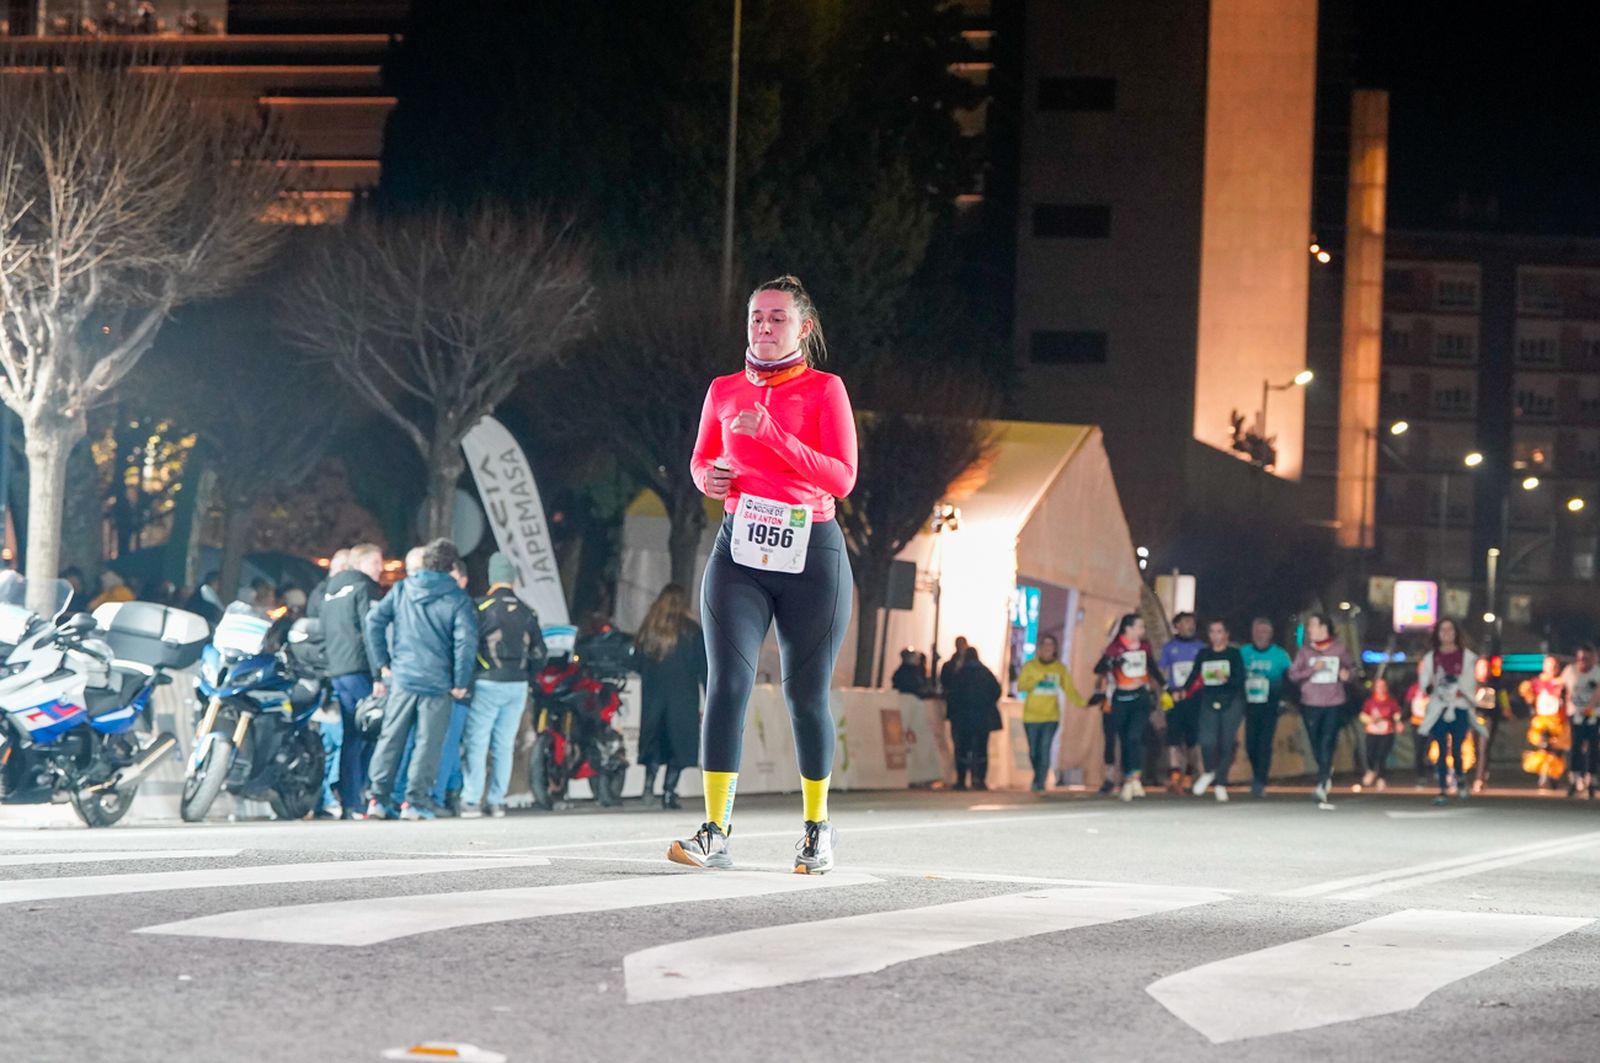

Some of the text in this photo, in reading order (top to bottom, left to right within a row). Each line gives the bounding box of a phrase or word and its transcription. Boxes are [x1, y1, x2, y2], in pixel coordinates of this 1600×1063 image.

[499, 447, 555, 583] JAPEMASA
[743, 510, 757, 520] SAN
[753, 505, 774, 515] NOCHE
[775, 508, 784, 517] DE
[747, 522, 794, 548] 1956
